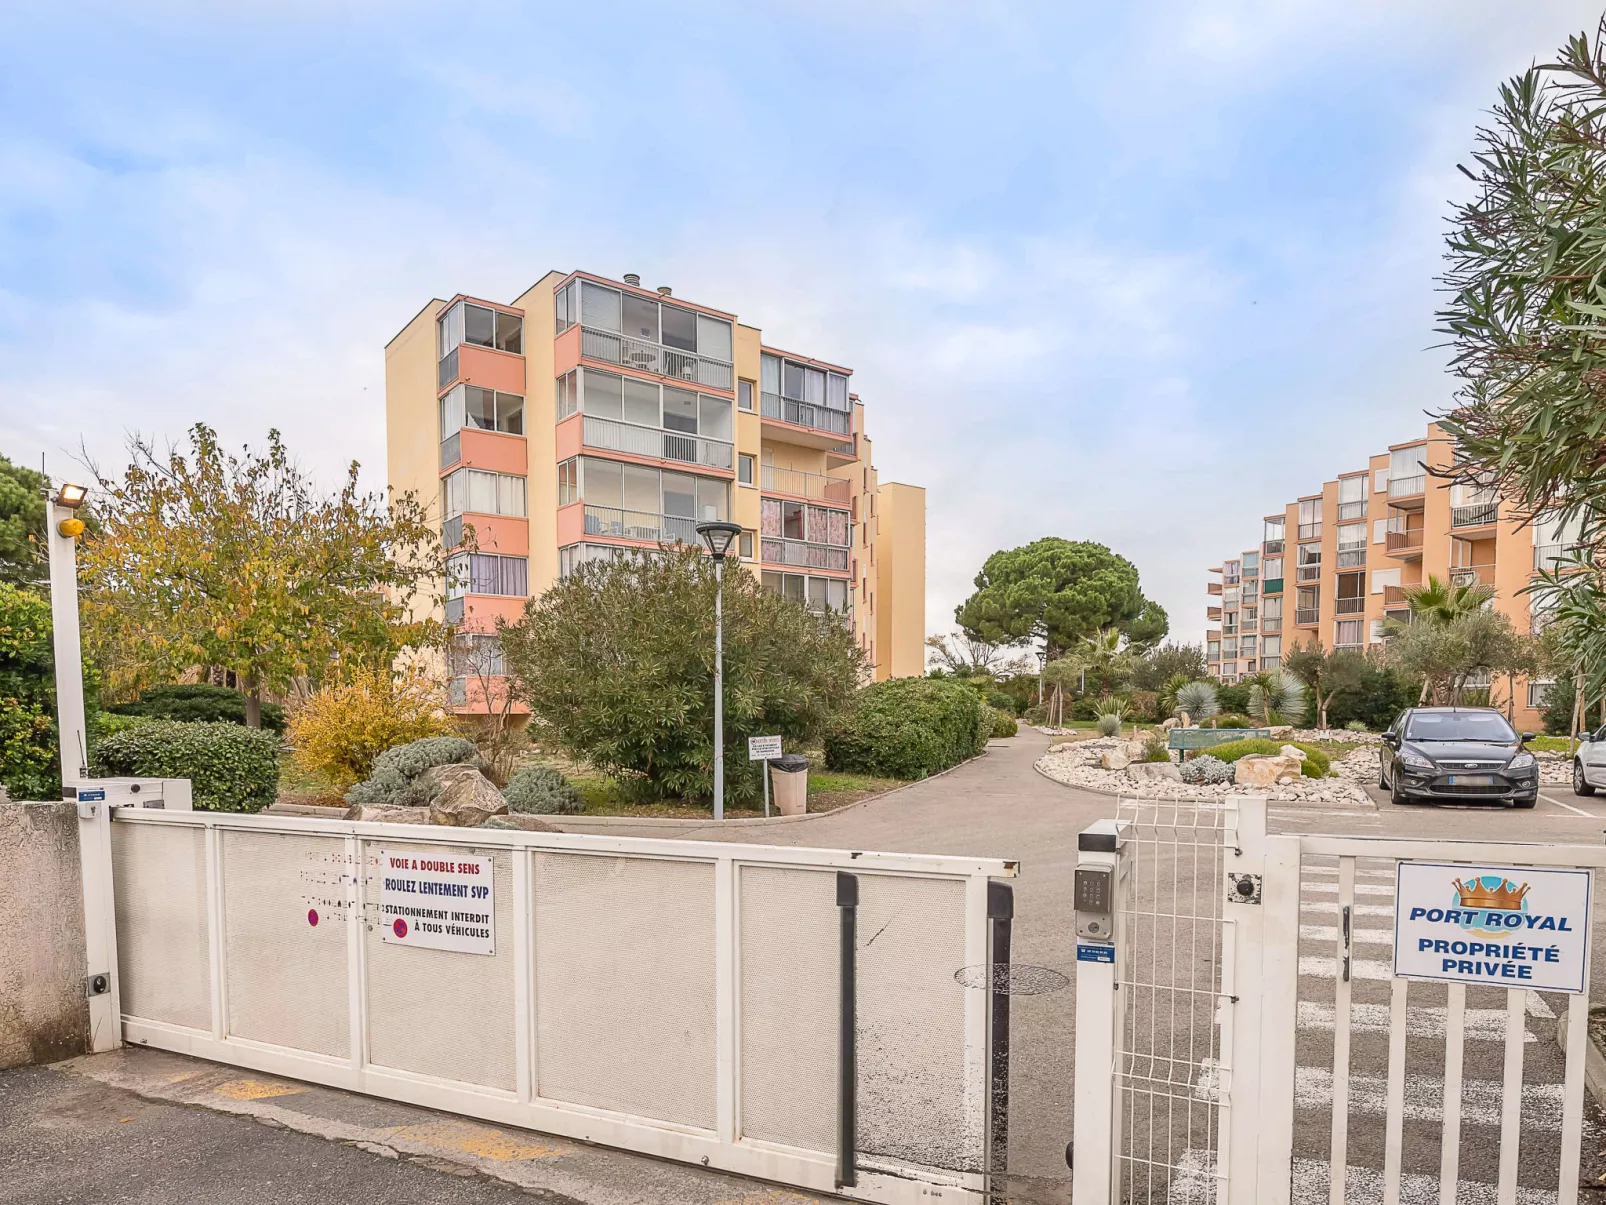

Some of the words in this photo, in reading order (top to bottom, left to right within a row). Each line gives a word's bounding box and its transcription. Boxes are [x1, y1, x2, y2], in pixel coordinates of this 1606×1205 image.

[390, 857, 409, 869] VOIE
[411, 860, 418, 870] A
[420, 860, 455, 873] DOUBLE
[457, 863, 480, 875] SENS
[385, 877, 417, 893] ROULEZ
[419, 881, 469, 898] LENTEMENT
[471, 886, 489, 899] SVP
[385, 904, 448, 921] STATIONNEMENT
[451, 911, 490, 925] INTERDIT
[1409, 907, 1478, 924] PORT
[1485, 913, 1572, 932] ROYAL
[414, 919, 421, 932] À
[422, 922, 443, 934] TOUS
[445, 923, 490, 939] VÉHICULES
[1418, 938, 1560, 963] PROPRIÉTÉ
[1442, 958, 1533, 980] PRIVÉE
